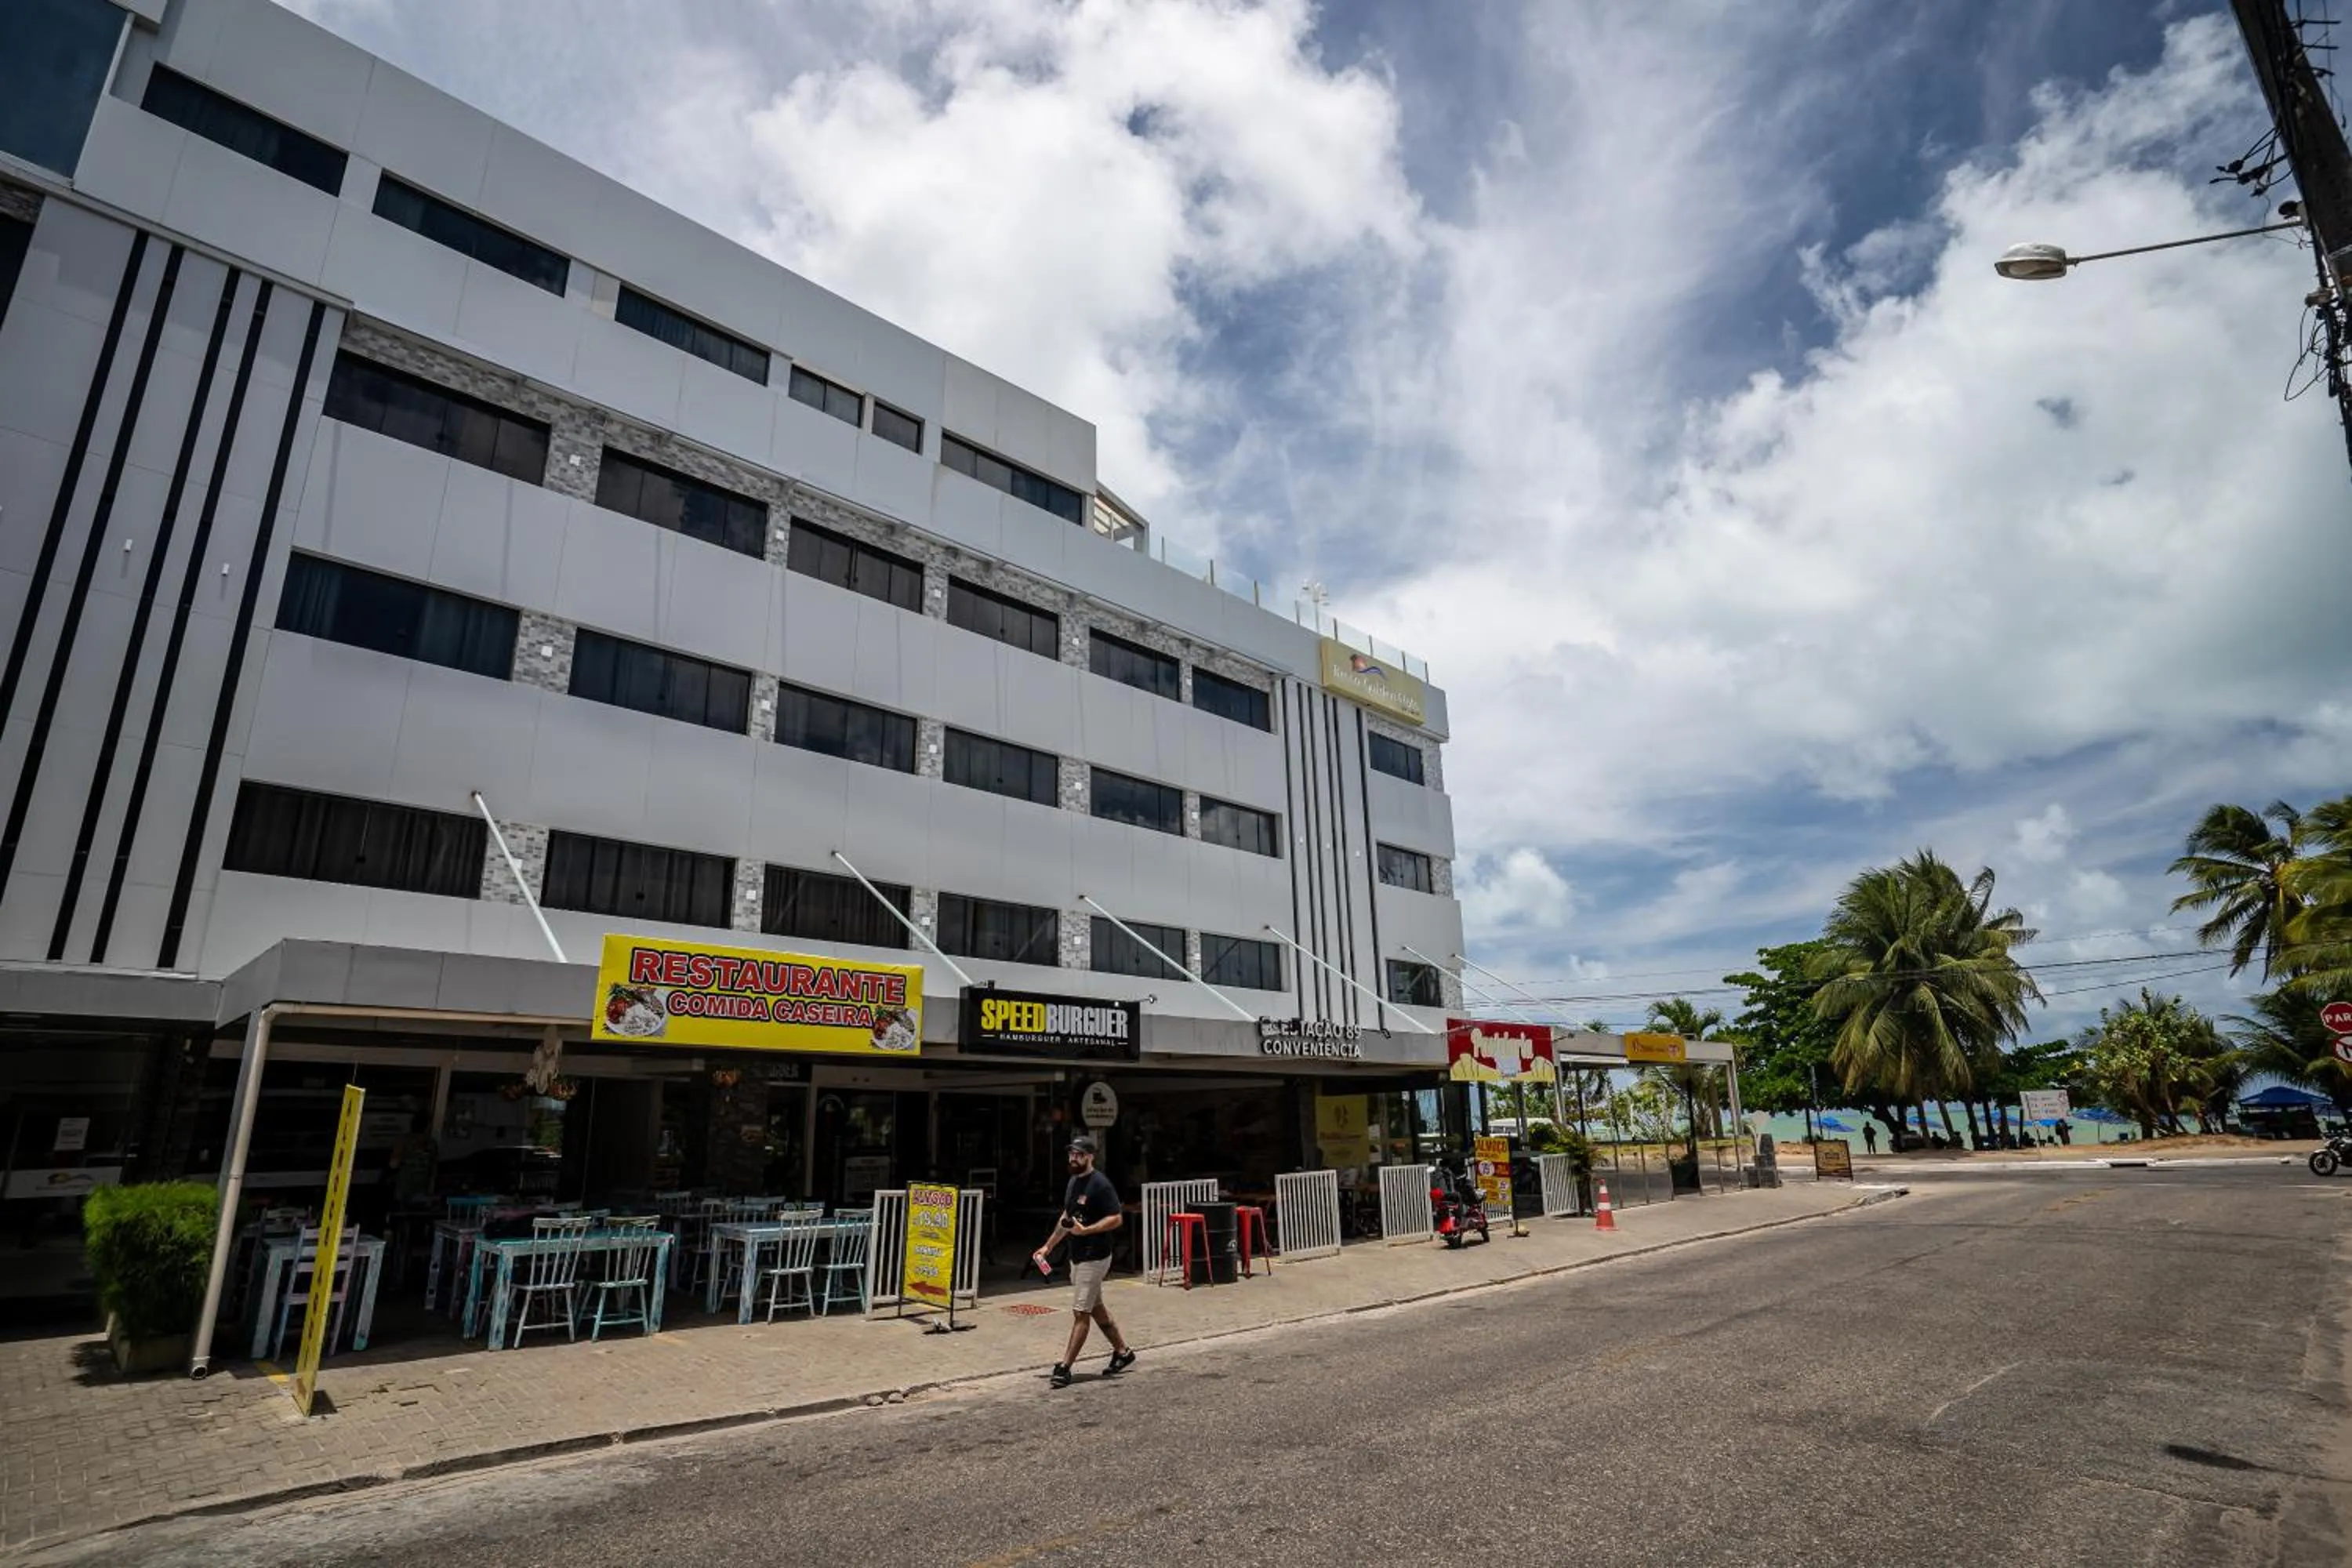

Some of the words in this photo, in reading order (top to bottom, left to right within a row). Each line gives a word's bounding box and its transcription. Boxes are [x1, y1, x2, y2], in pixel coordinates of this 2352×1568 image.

[630, 948, 906, 1004] RESTAURANTE
[668, 991, 769, 1020] COMIDA
[774, 1001, 873, 1028] CASEIRA
[2325, 1012, 2352, 1023] PAR
[1000, 1033, 1062, 1044] HAMBURGUER
[1068, 1036, 1116, 1047] ARTESANAL
[1263, 1038, 1362, 1058] CONVENIÊNCIA
